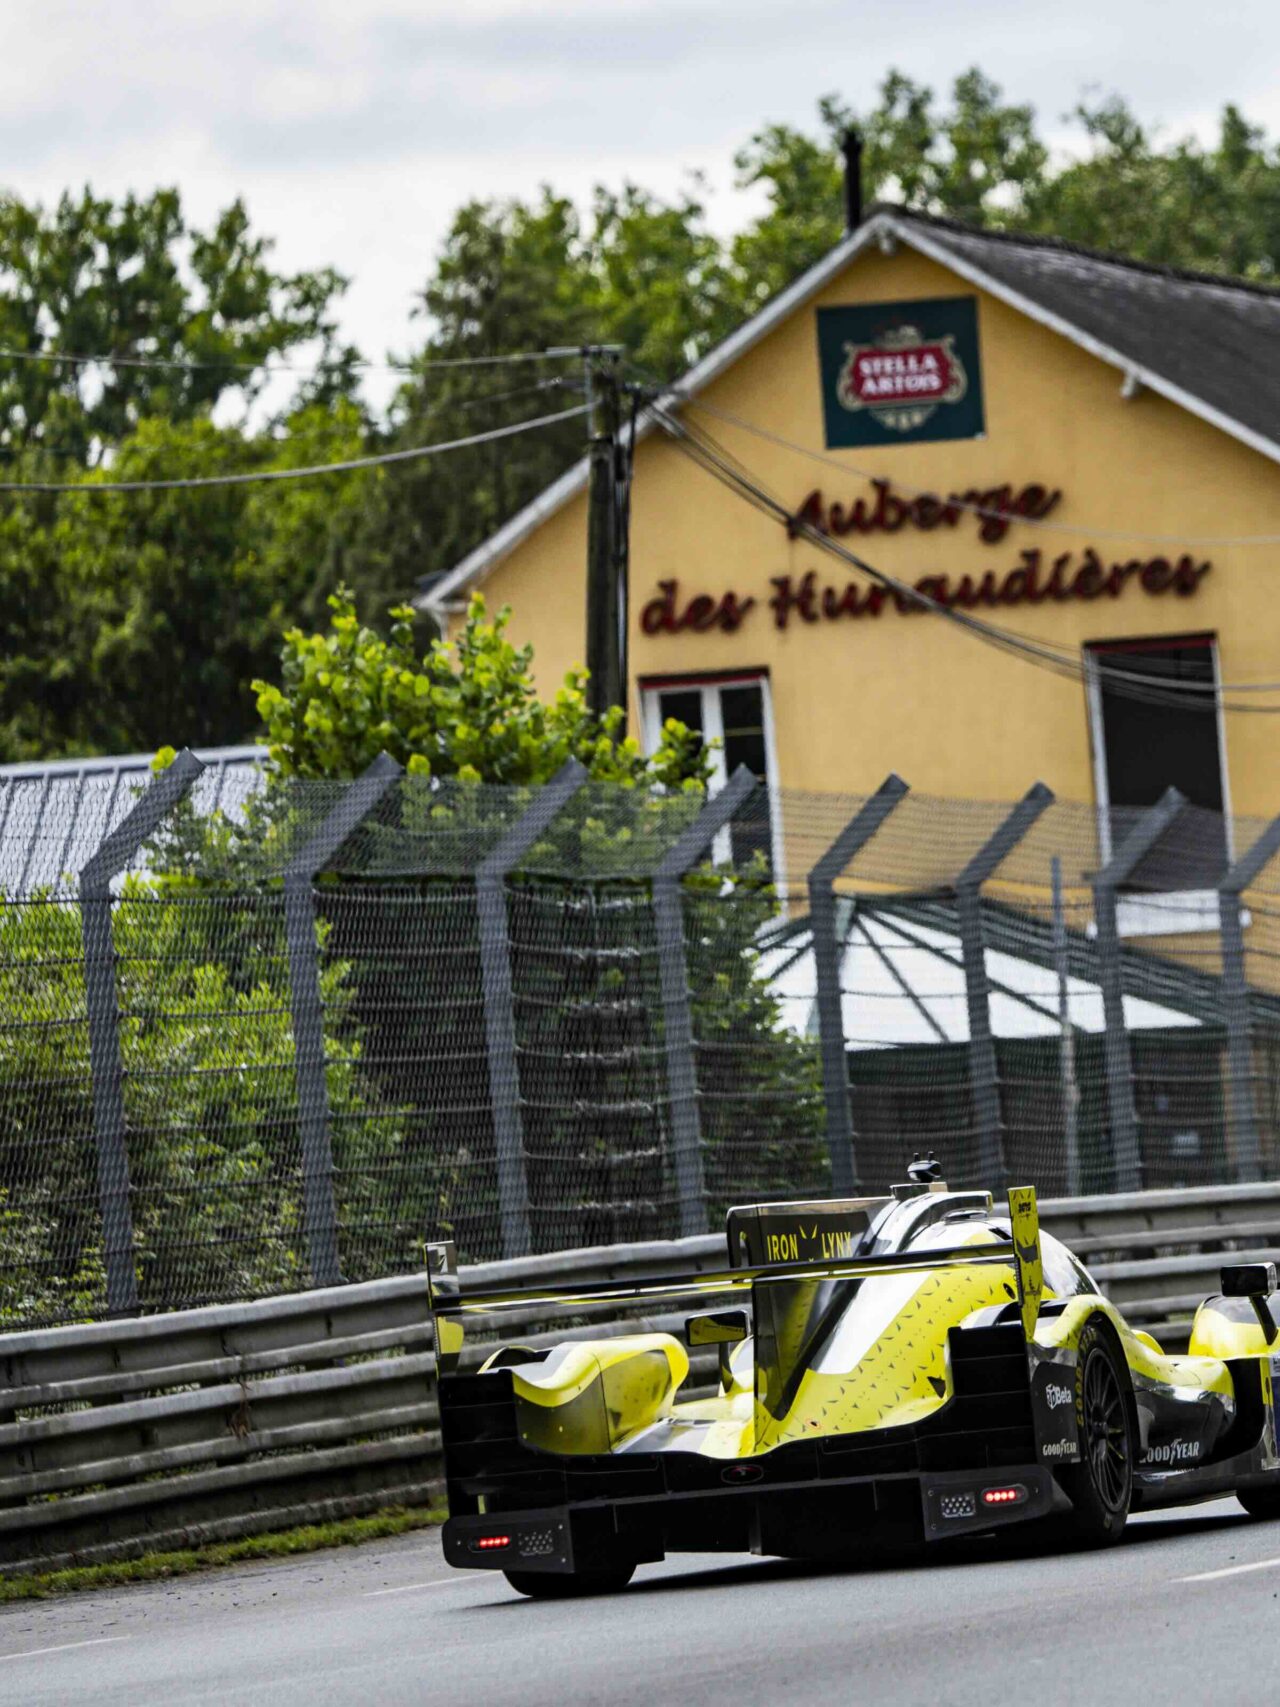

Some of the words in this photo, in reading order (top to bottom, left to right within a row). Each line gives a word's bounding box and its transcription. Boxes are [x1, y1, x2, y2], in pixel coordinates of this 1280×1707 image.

[858, 353, 940, 376] STELLA
[861, 373, 942, 395] ARTOIS
[786, 477, 1062, 545] Auberge
[640, 578, 754, 638] des
[769, 547, 1211, 632] Hunaudières
[766, 1233, 799, 1262] IRON
[821, 1230, 852, 1260] LYNX
[1056, 1385, 1073, 1405] Beta
[1042, 1438, 1077, 1458] GOODYEAR
